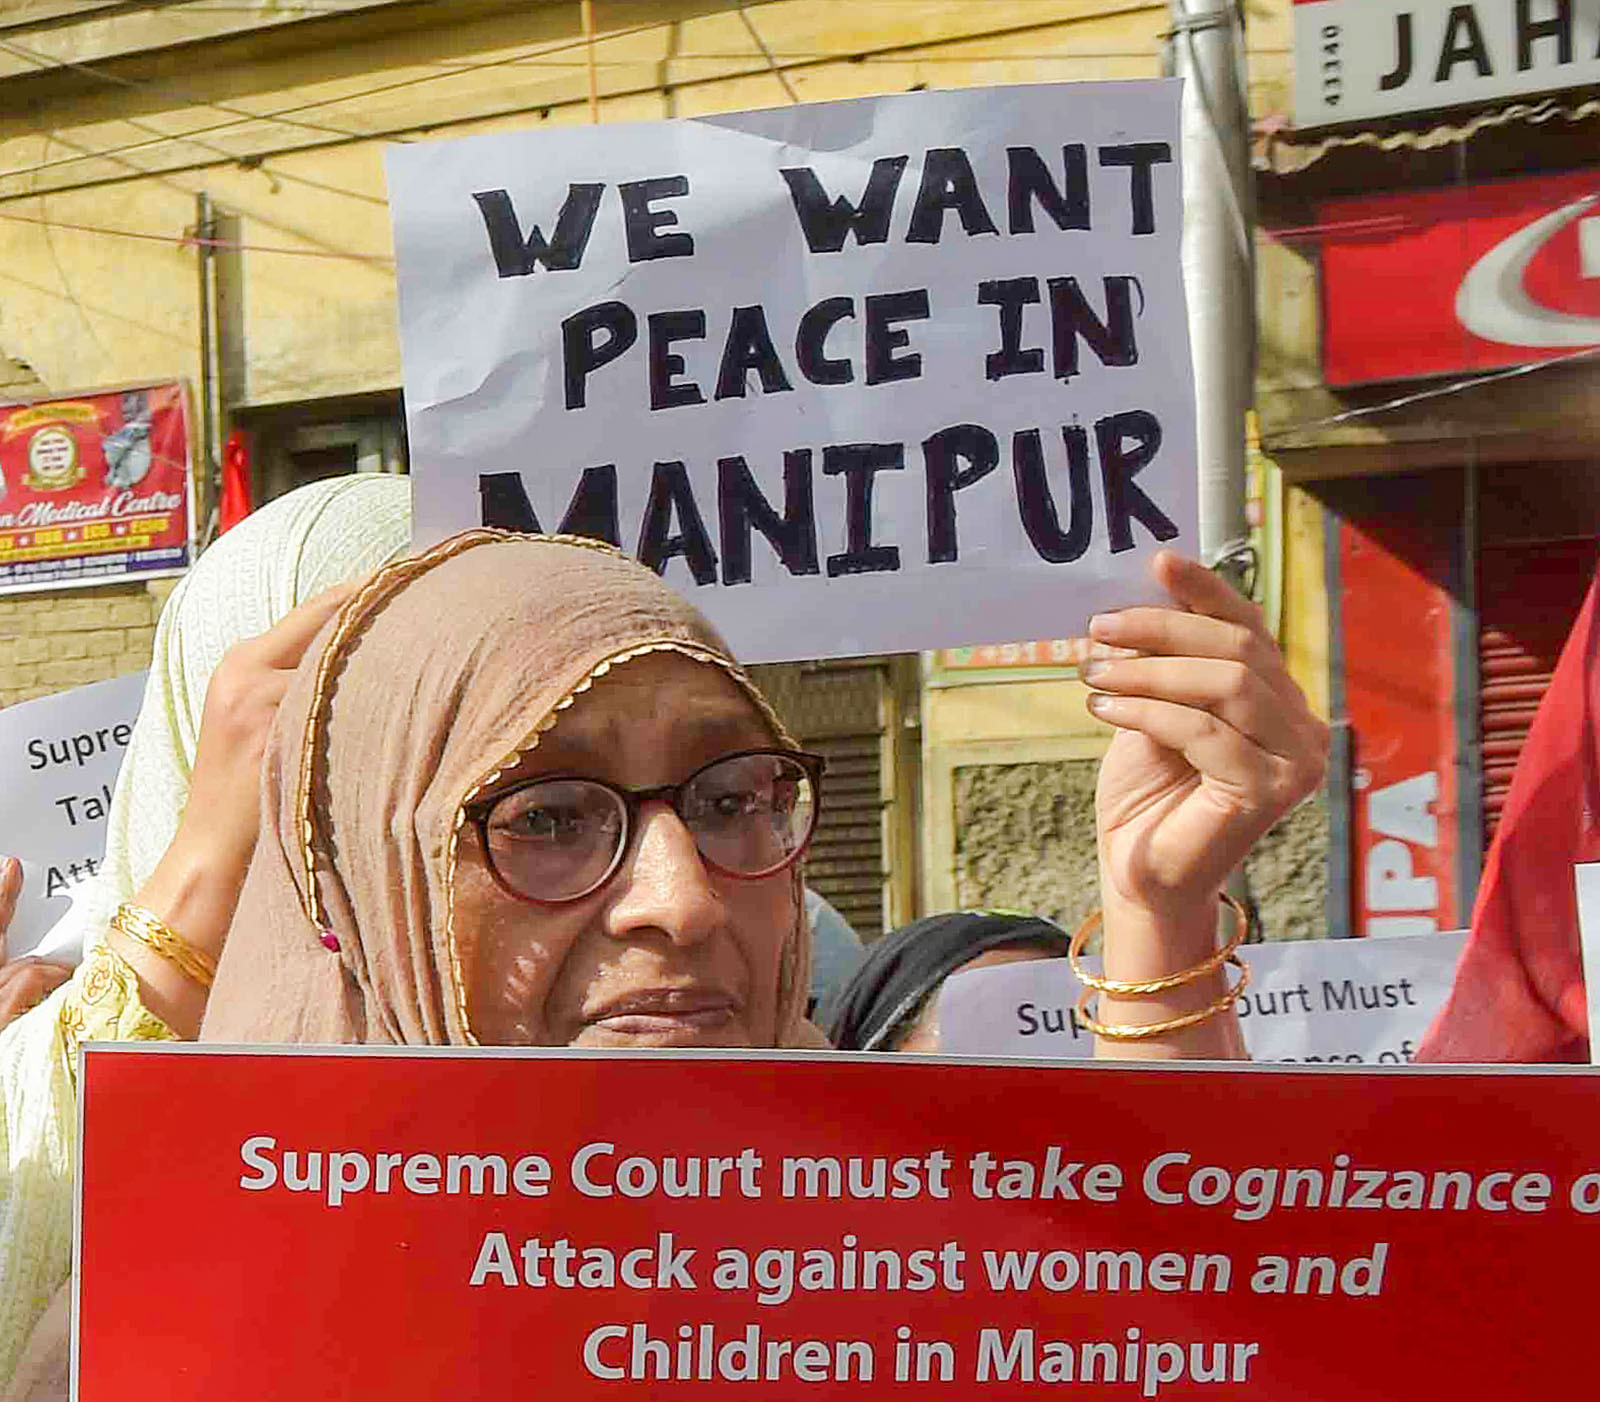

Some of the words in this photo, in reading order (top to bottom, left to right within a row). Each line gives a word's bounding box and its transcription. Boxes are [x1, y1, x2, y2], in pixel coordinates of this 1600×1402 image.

[1377, 0, 1600, 91] JAH
[472, 174, 694, 279] WE
[780, 141, 1173, 253] WANT
[562, 288, 930, 411] PEACE
[977, 275, 1144, 387] IN
[19, 496, 110, 526] Medical
[479, 409, 1180, 588] MANIPUR
[27, 722, 132, 770] Supre
[1322, 977, 1418, 1011] Must
[240, 1137, 551, 1206] Supreme
[572, 1143, 762, 1197] Court
[783, 1151, 951, 1198] must
[970, 1147, 1122, 1201] take
[1143, 1153, 1551, 1220] Cognizance
[1571, 1173, 1600, 1213] o
[470, 1233, 697, 1288] Attack
[713, 1235, 965, 1304] against
[983, 1251, 1230, 1291] women
[1251, 1243, 1388, 1295] and
[584, 1324, 872, 1381] Children
[896, 1327, 954, 1381] in
[976, 1328, 1258, 1396] Manipur
